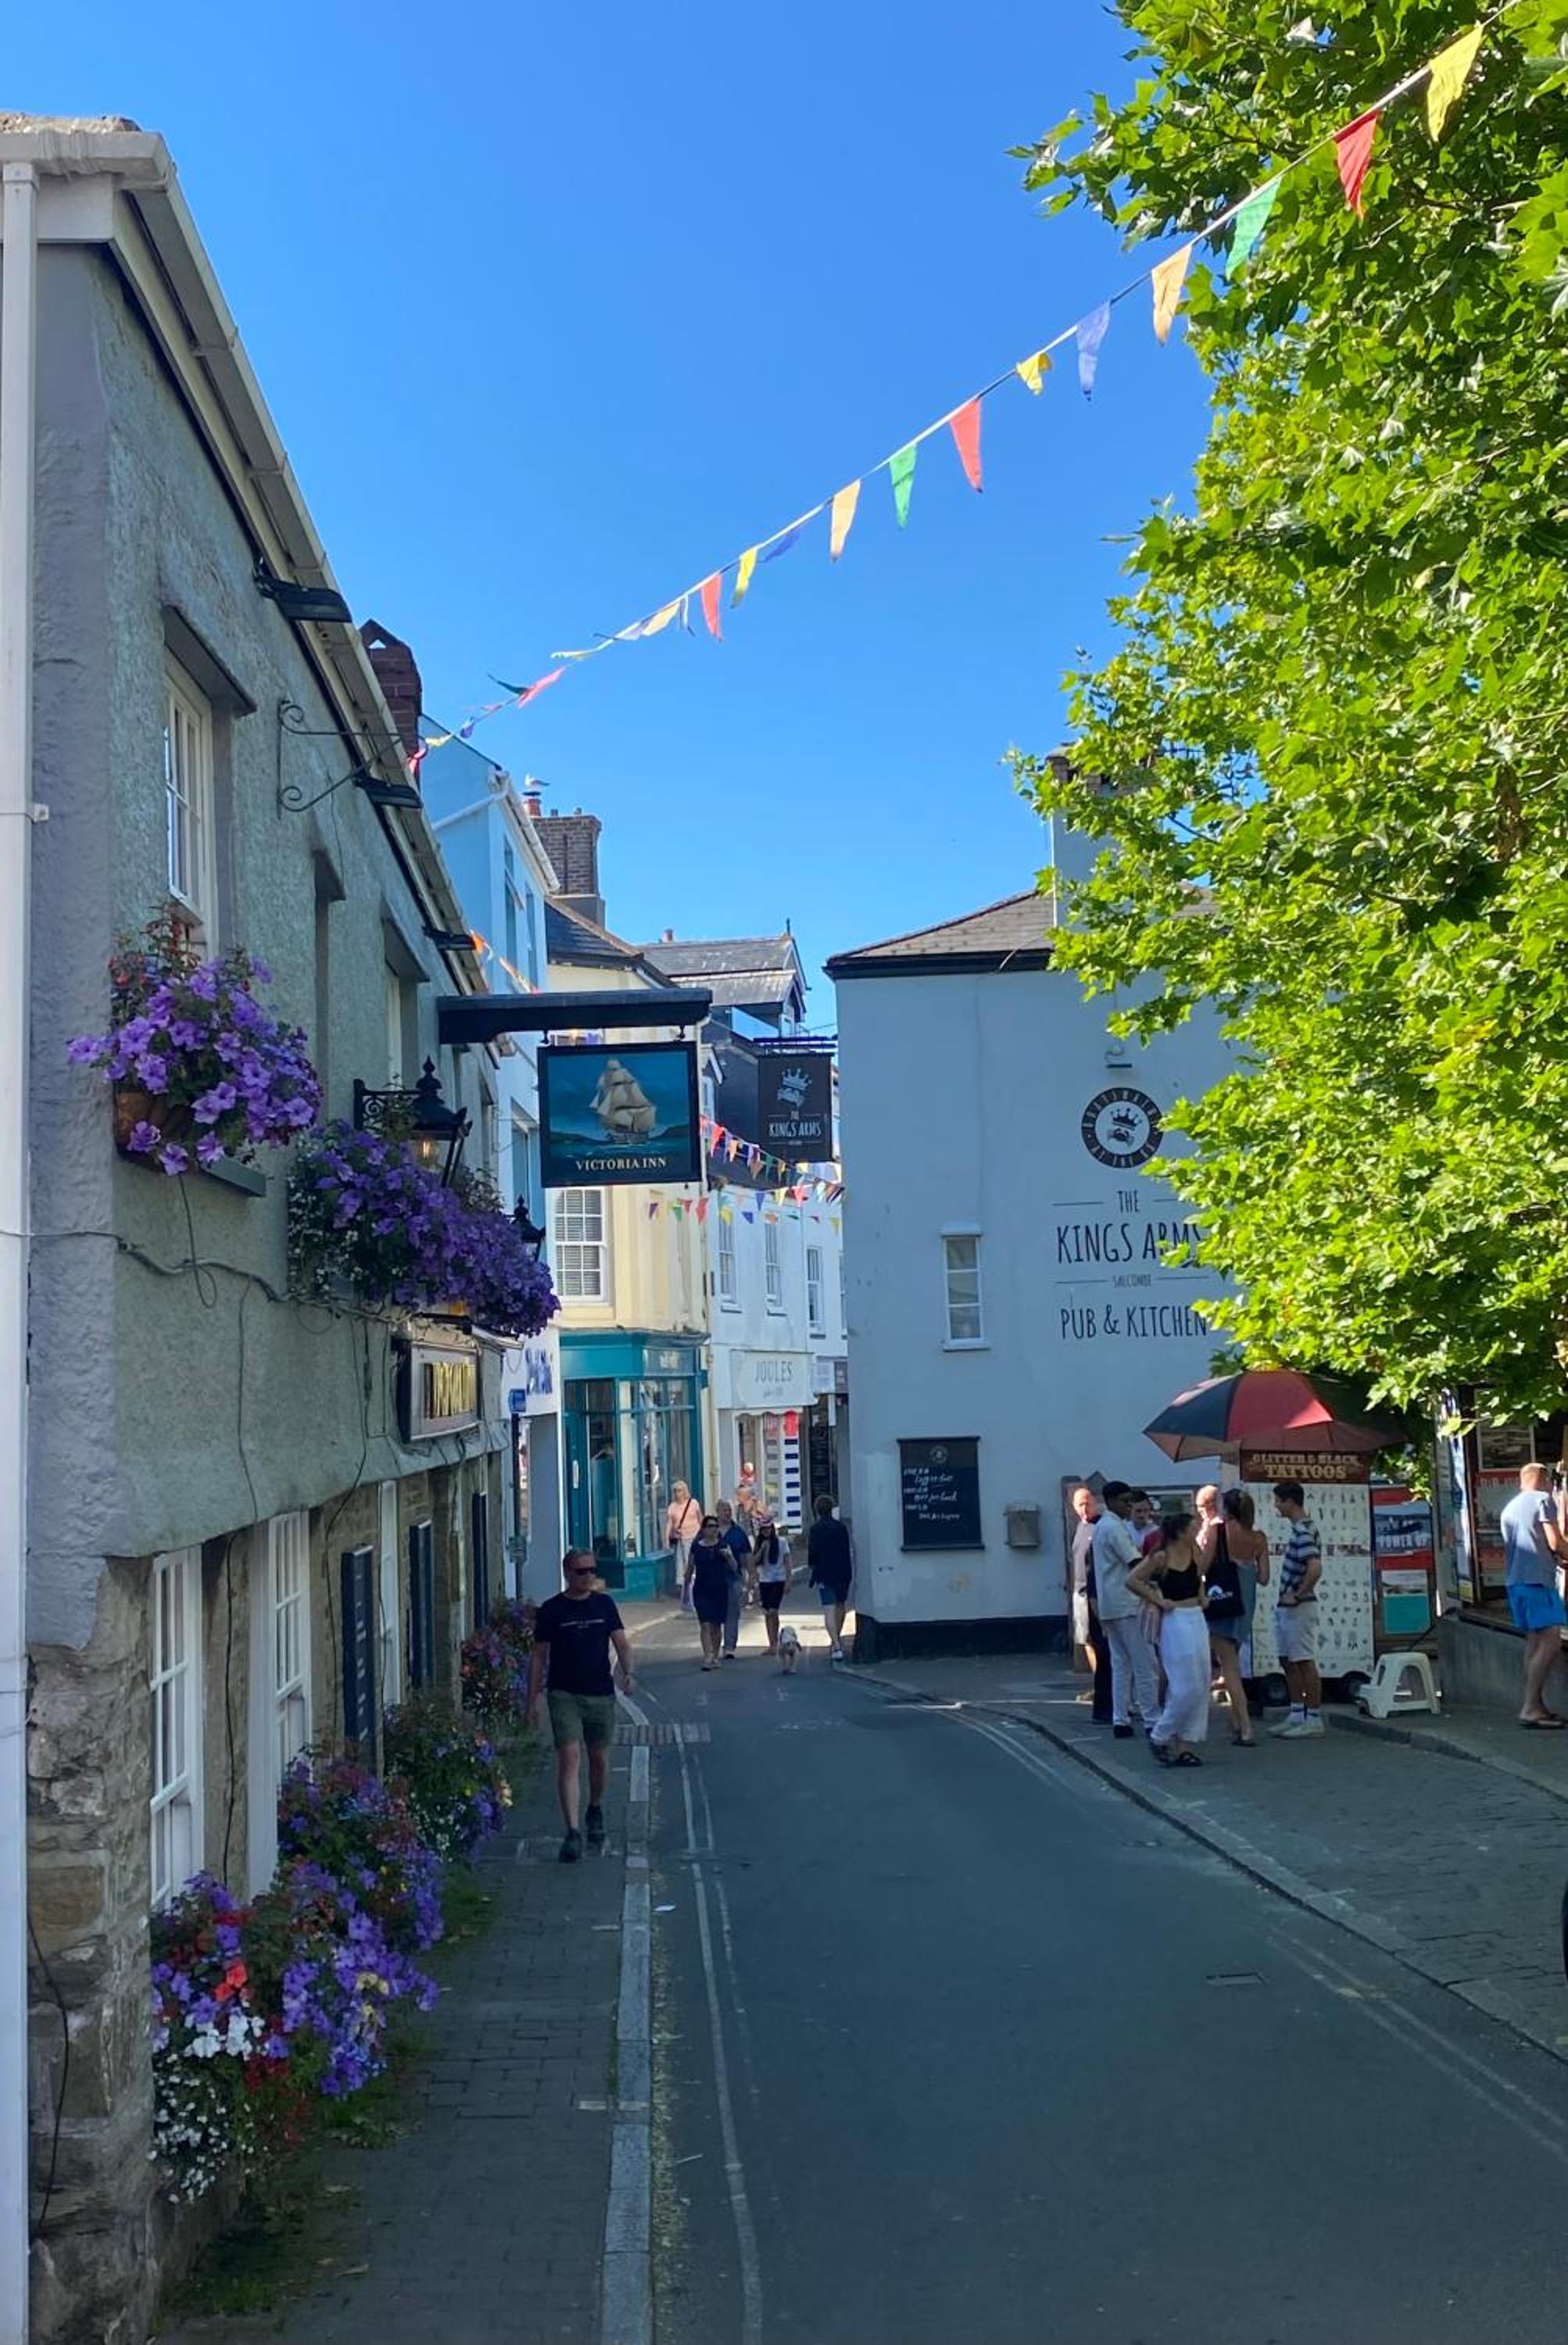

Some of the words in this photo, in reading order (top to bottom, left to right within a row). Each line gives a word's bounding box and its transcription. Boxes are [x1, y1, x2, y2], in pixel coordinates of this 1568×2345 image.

[768, 1121, 797, 1137] KINGS
[799, 1121, 822, 1137] ARMS
[575, 1158, 639, 1171] VICTORIA
[643, 1157, 667, 1169] INN
[1117, 1190, 1140, 1213] THE
[1057, 1223, 1133, 1264] KINGS
[1061, 1308, 1097, 1340] PUB
[1103, 1304, 1121, 1334] &
[1126, 1306, 1208, 1338] KITCHEN
[1317, 1455, 1359, 1464] BLACK
[1264, 1464, 1347, 1478] TATTOOS
